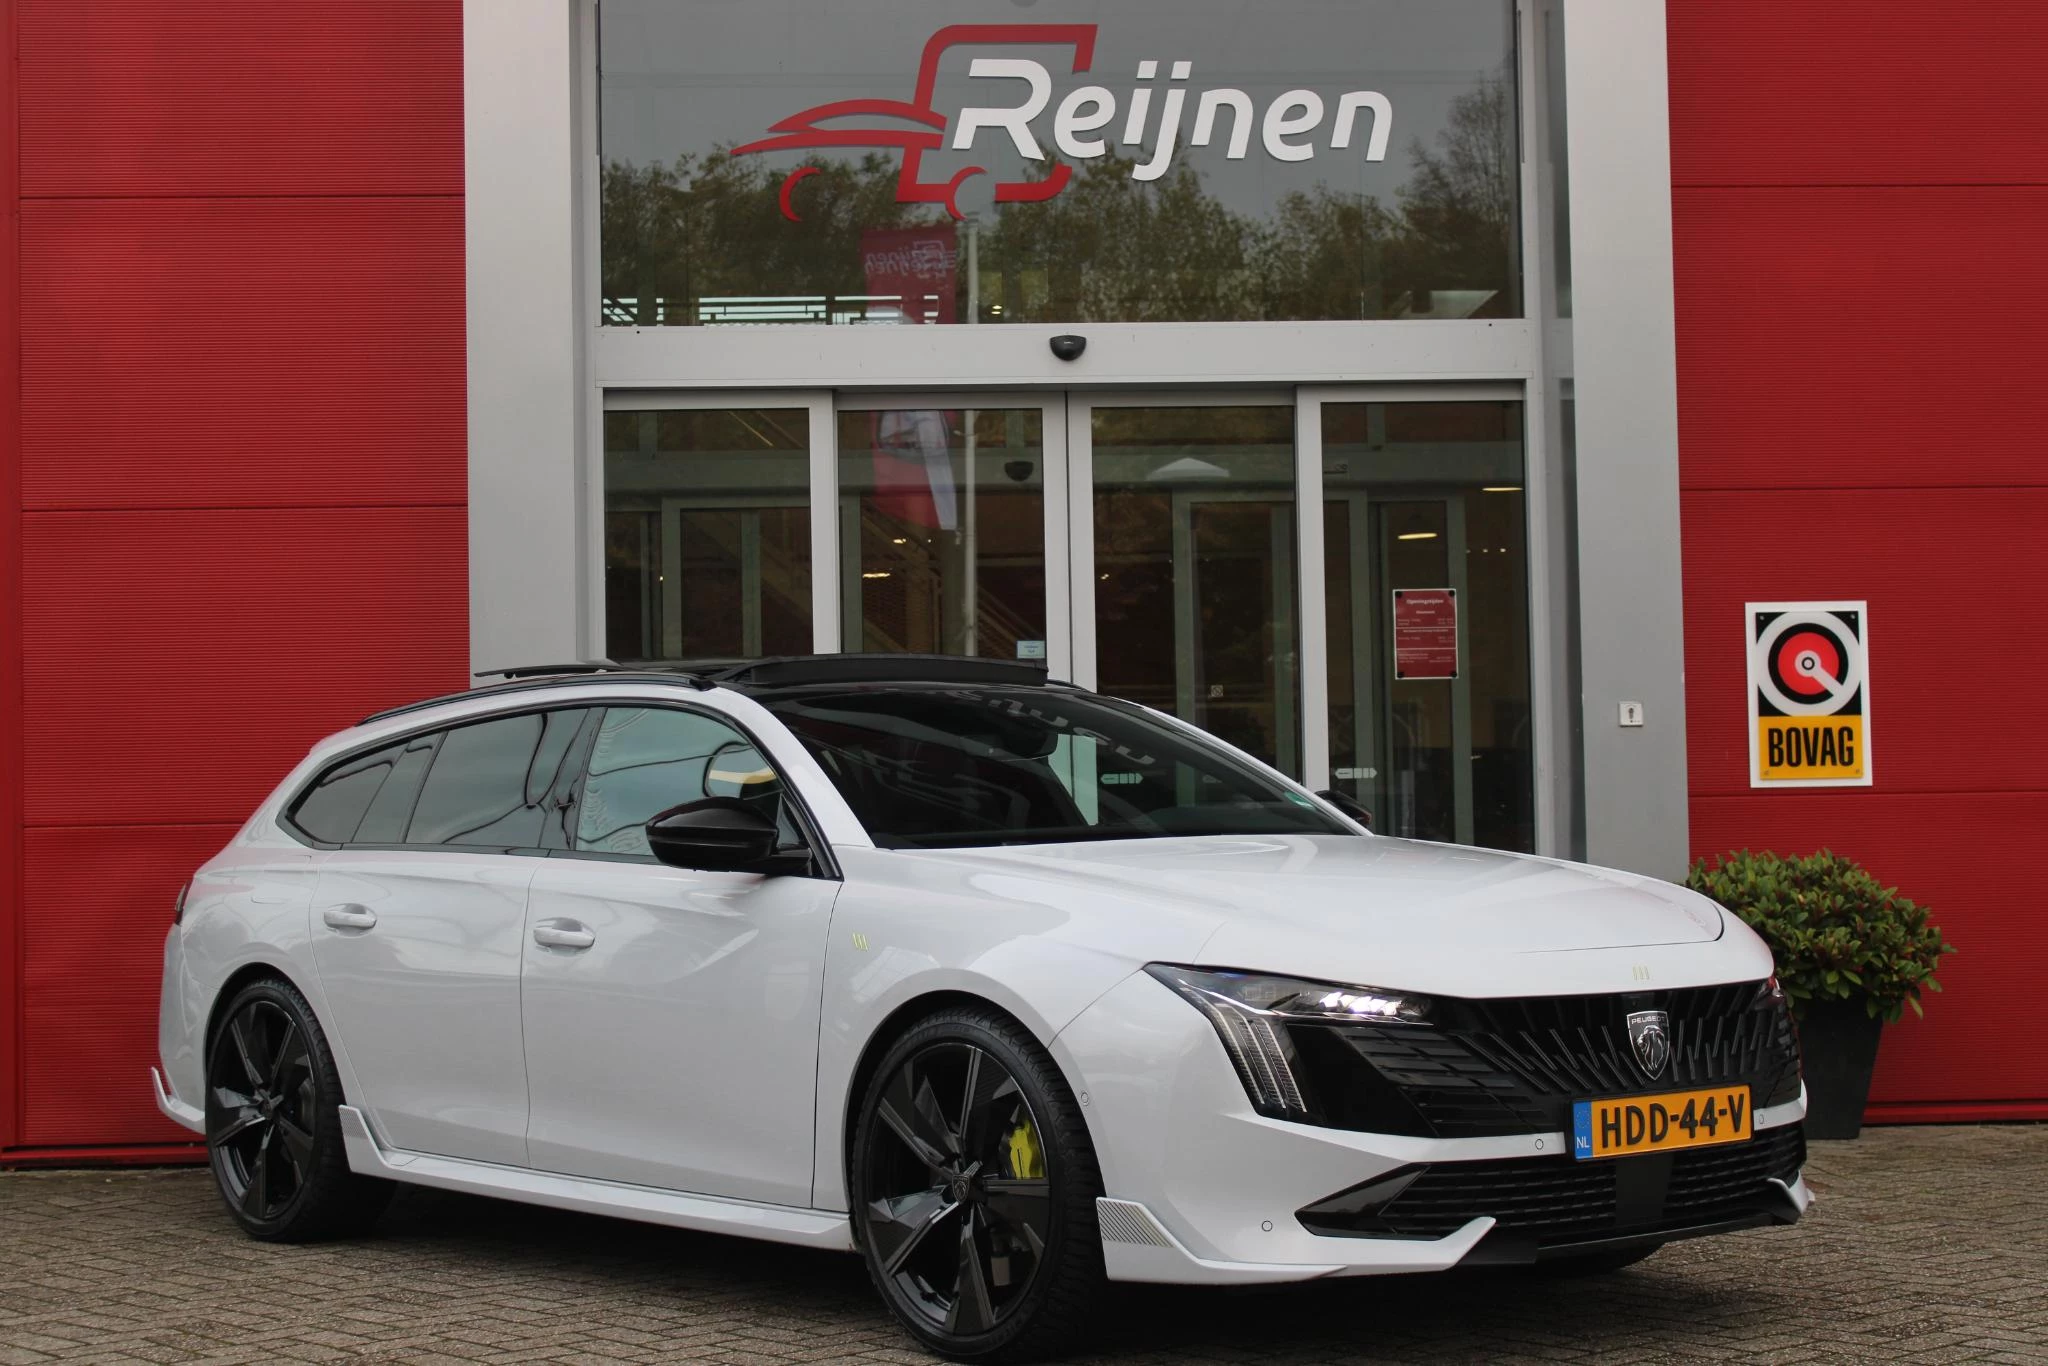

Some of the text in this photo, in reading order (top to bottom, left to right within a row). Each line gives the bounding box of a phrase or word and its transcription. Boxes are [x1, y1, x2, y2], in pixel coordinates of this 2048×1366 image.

[952, 57, 1394, 182] Reijnen
[1767, 726, 1855, 768] BOVAG
[1631, 1015, 1665, 1025] PEUGEOT
[1601, 1093, 1745, 1149] HDD-44-V
[1576, 1136, 1590, 1149] NL
